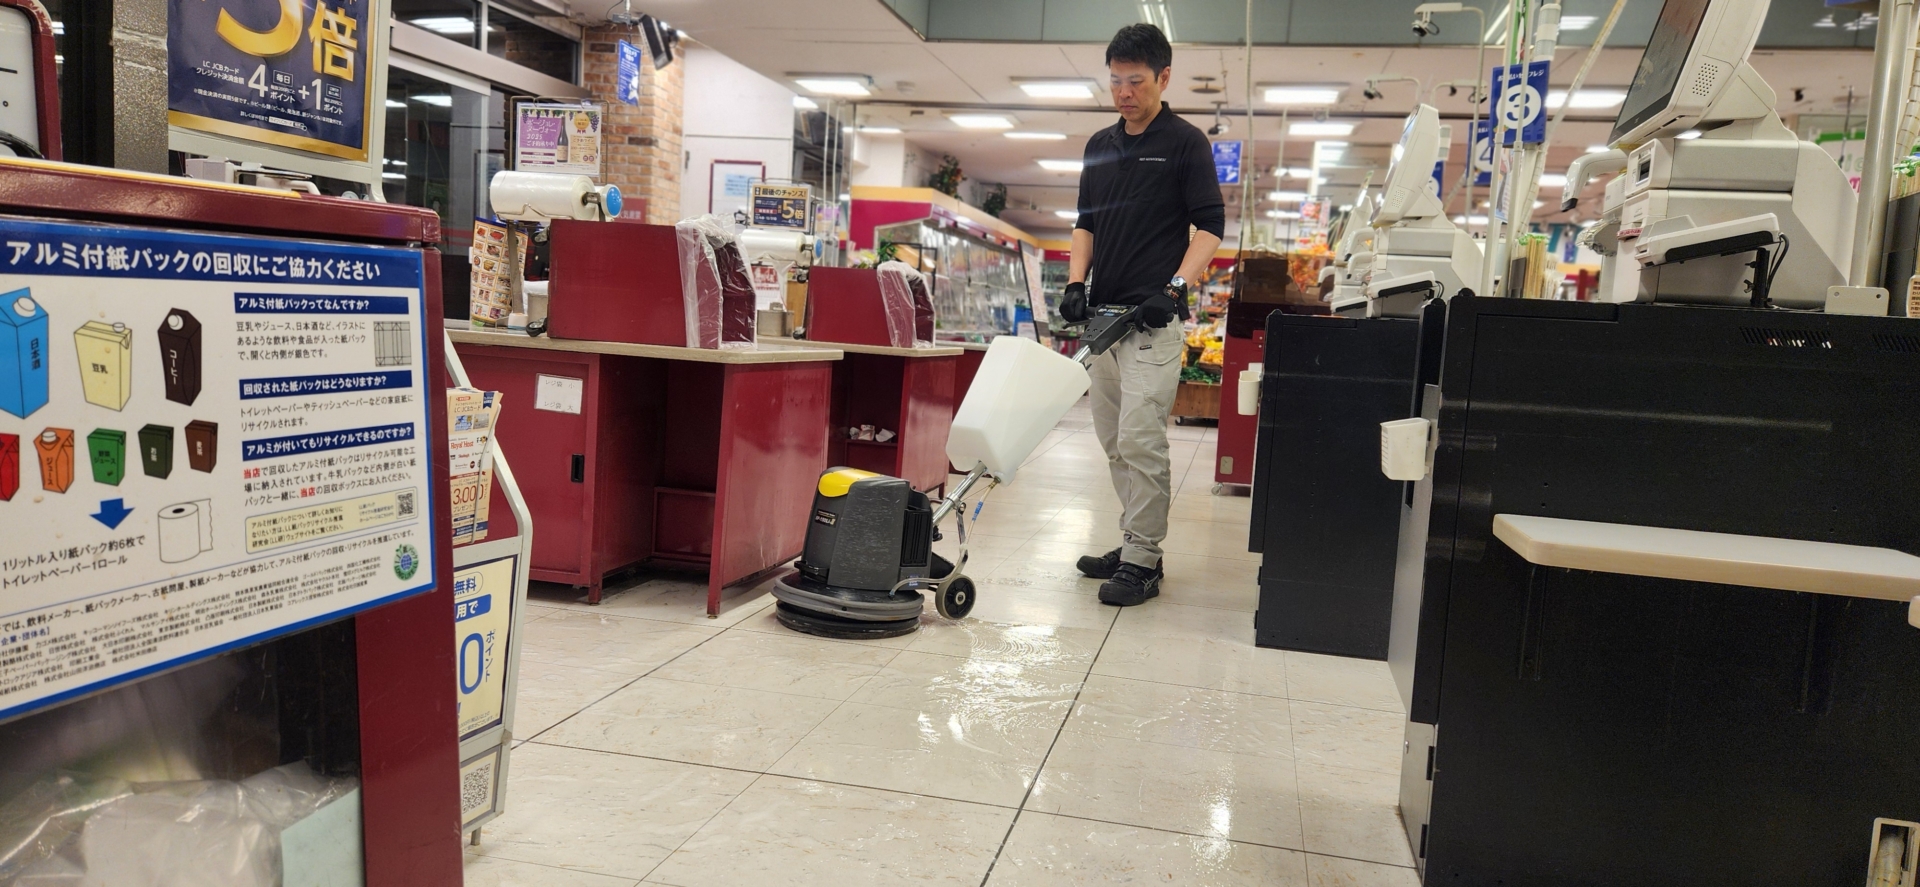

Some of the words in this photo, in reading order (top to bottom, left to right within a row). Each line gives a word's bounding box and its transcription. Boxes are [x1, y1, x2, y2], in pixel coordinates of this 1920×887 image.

[203, 60, 211, 69] LC
[247, 64, 269, 98] 4
[276, 73, 291, 85] 毎日
[270, 91, 296, 104] ポイント
[323, 103, 344, 115] ポイント
[1506, 92, 1531, 121] 3
[6, 240, 381, 281] アルミ付紙パックの回収にご協力ください
[239, 297, 370, 311] アルミ付紙パックってなんですか?
[236, 320, 367, 334] 豆乳やジュース、日本酒など、イラストに
[237, 335, 367, 347] あるような飲料や食品が入った紙パック
[30, 338, 42, 371] 日本酒
[238, 348, 329, 361] で、開くと内側が銀色です。
[91, 362, 108, 375] 豆乳
[169, 349, 178, 385] コーヒー
[244, 375, 387, 396] 回収された紙パックはどうなりますか?
[240, 395, 414, 418] トイレットペーパーやティッシュペーパーなどの家庭紙に
[241, 417, 309, 433] リサイクルされます。
[247, 427, 412, 456] アルミが付いてもリサイクルできるのですか?
[94, 457, 116, 466] ジュース
[243, 447, 417, 480] 当店で回収したアルミ付紙パックはリサイクル可能な工
[244, 458, 417, 492] 場に納入されています。牛乳パックなど内側が白い紙
[2, 535, 146, 571] 1リットル入り紙パック約6枚で
[2, 556, 128, 590] トイレットペーパー1ロール
[460, 632, 484, 695] 0
[485, 628, 496, 683] ポイント
